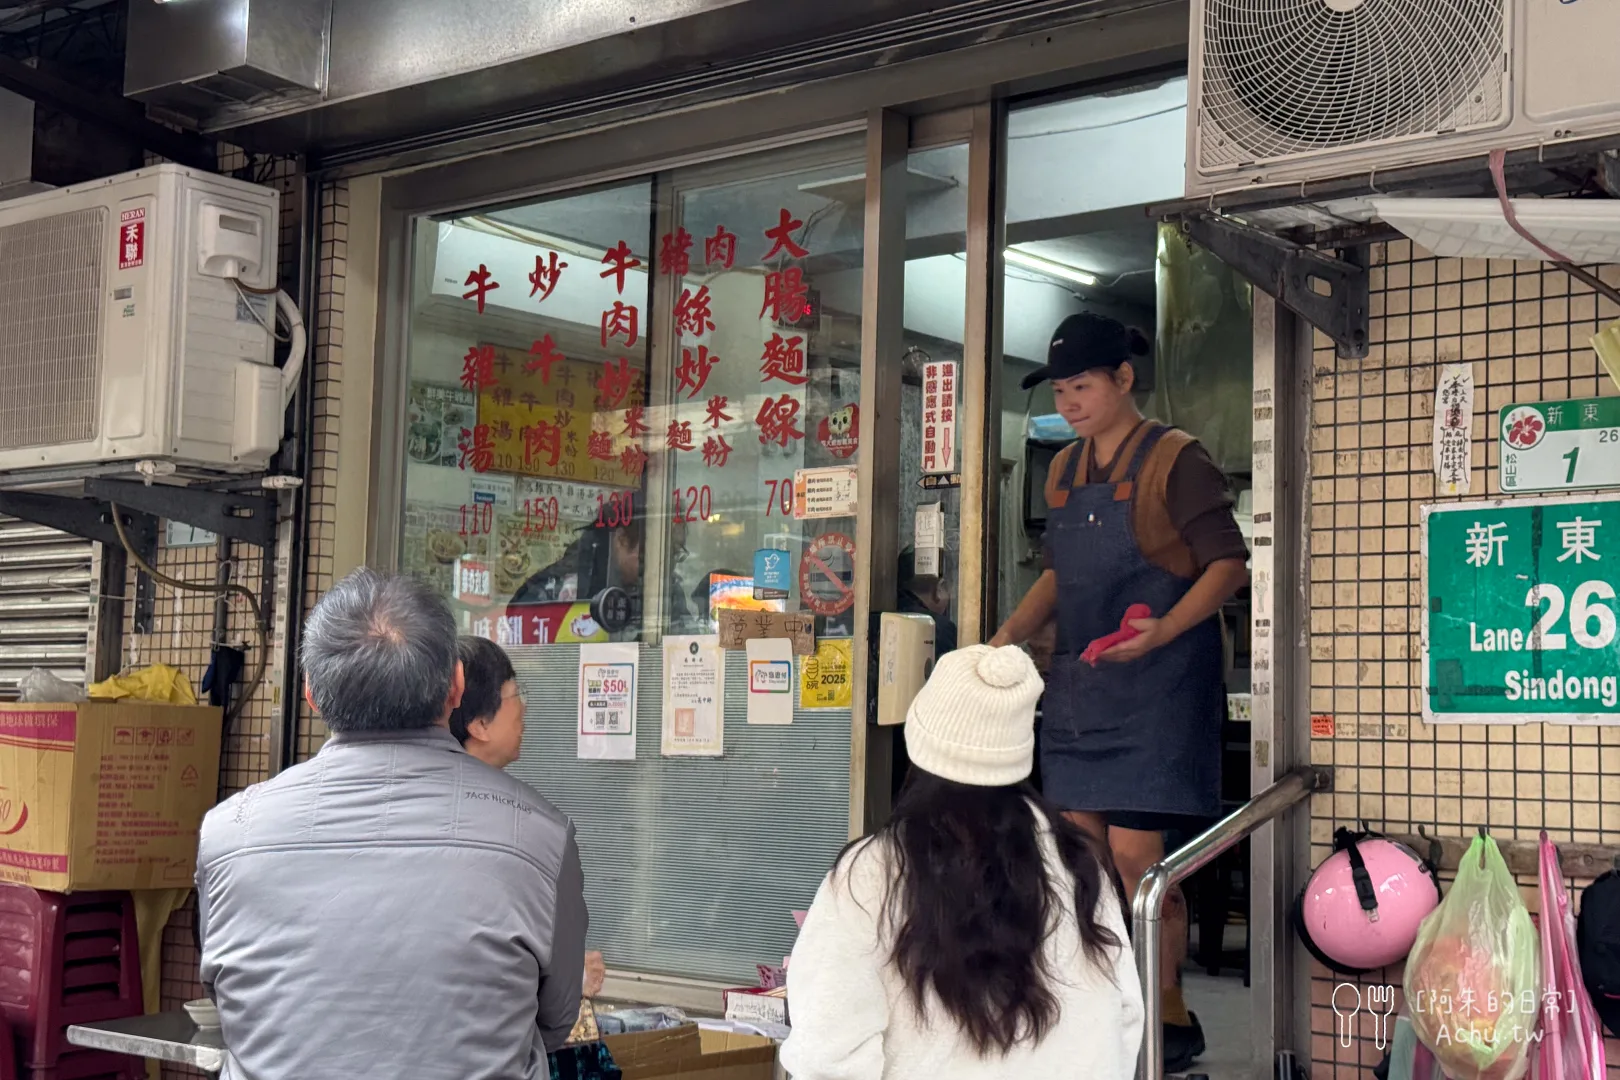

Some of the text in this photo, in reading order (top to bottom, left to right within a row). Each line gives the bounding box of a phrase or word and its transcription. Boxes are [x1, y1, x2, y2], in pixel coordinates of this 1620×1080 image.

[121, 208, 144, 221] HERAN
[125, 223, 139, 261] 禾聯
[597, 240, 641, 409] 牛肉炒
[755, 208, 809, 447] 大腸麵線
[458, 264, 500, 473] 牛雜湯
[525, 252, 568, 467] 炒牛肉
[941, 363, 953, 423] 進出請按
[702, 395, 734, 468] 米粉
[924, 365, 938, 470] 非感應式自動門
[1547, 402, 1600, 426] 新東
[587, 430, 619, 461] 麵
[620, 405, 652, 477] 米粉
[666, 420, 696, 451] 麵
[1599, 430, 1619, 444] 26
[1505, 453, 1518, 487] 松山區
[1562, 446, 1580, 483] 1
[523, 497, 558, 533] 150
[595, 490, 633, 528] 130
[672, 485, 712, 523] 120
[765, 478, 794, 516] 70
[459, 502, 493, 536] 110
[1465, 516, 1602, 567] 新東
[728, 613, 803, 647] 營業中
[1470, 579, 1617, 651] Lane 26
[603, 679, 624, 693] $50
[821, 674, 846, 684] 2025
[1504, 669, 1617, 707] Sindong
[464, 791, 490, 800] JACK
